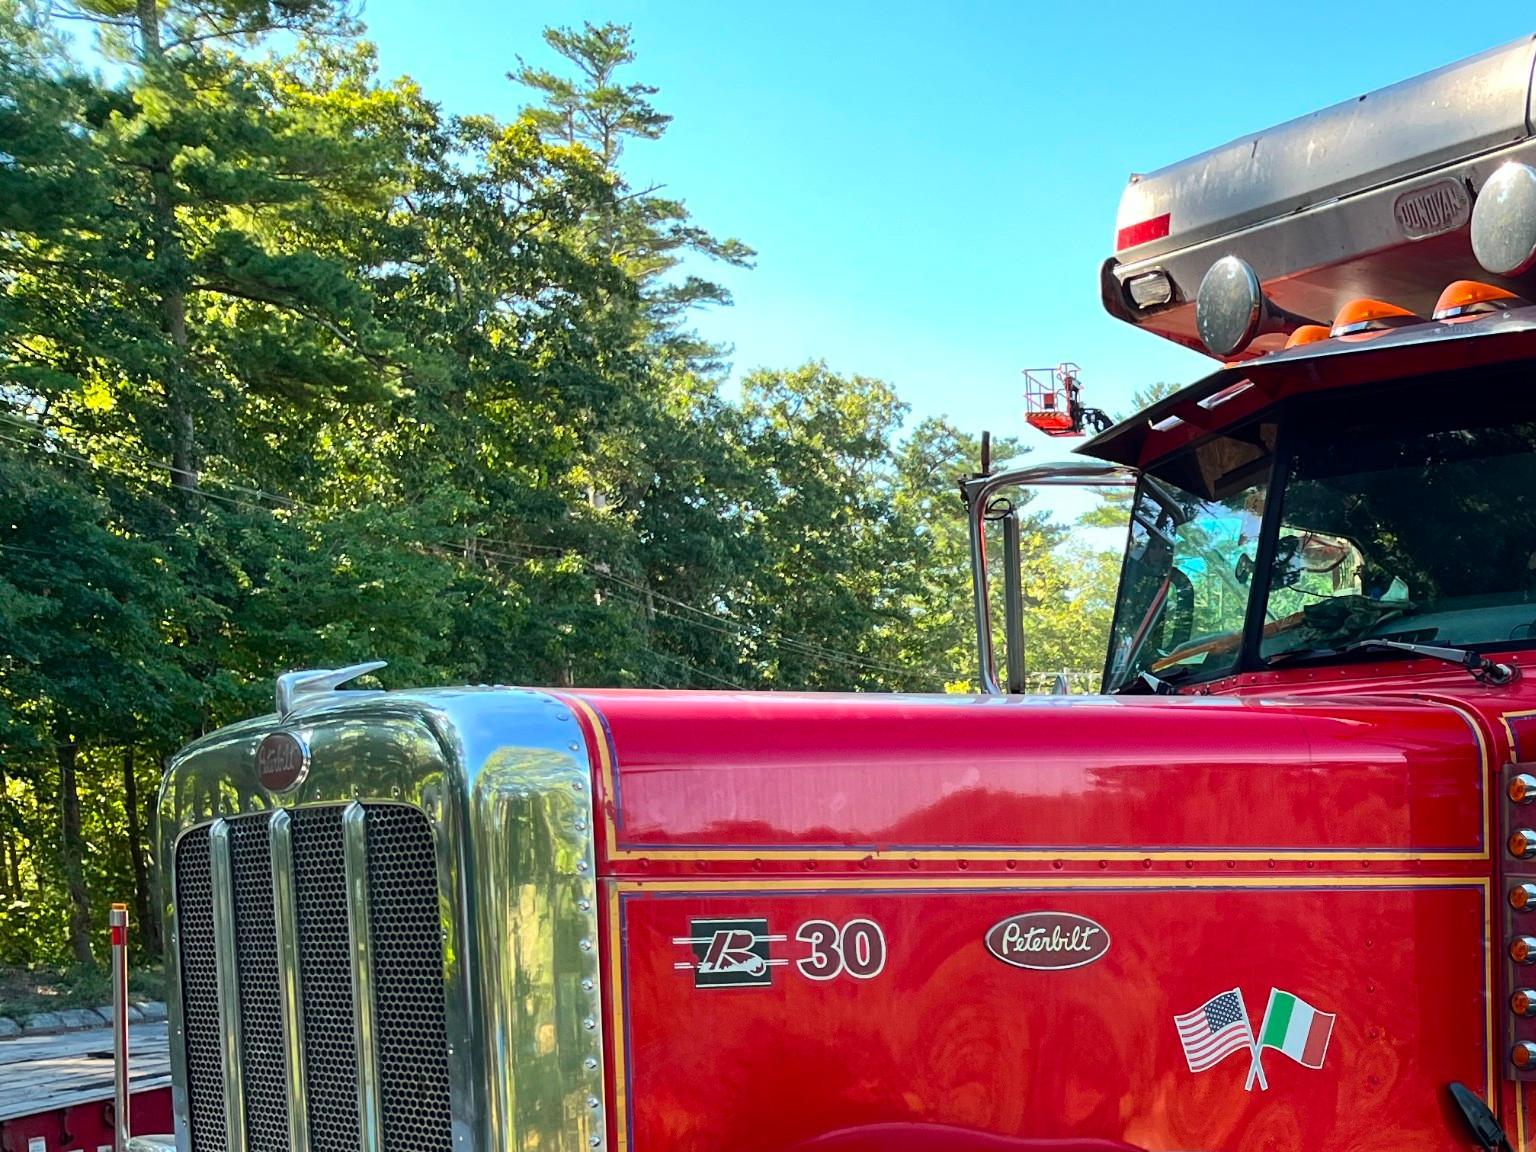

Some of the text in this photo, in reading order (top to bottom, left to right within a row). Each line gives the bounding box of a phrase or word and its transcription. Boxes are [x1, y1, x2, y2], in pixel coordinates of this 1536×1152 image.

[1400, 187, 1461, 229] DONOVAN
[795, 918, 887, 981] 30
[1002, 922, 1100, 955] Peterbilt
